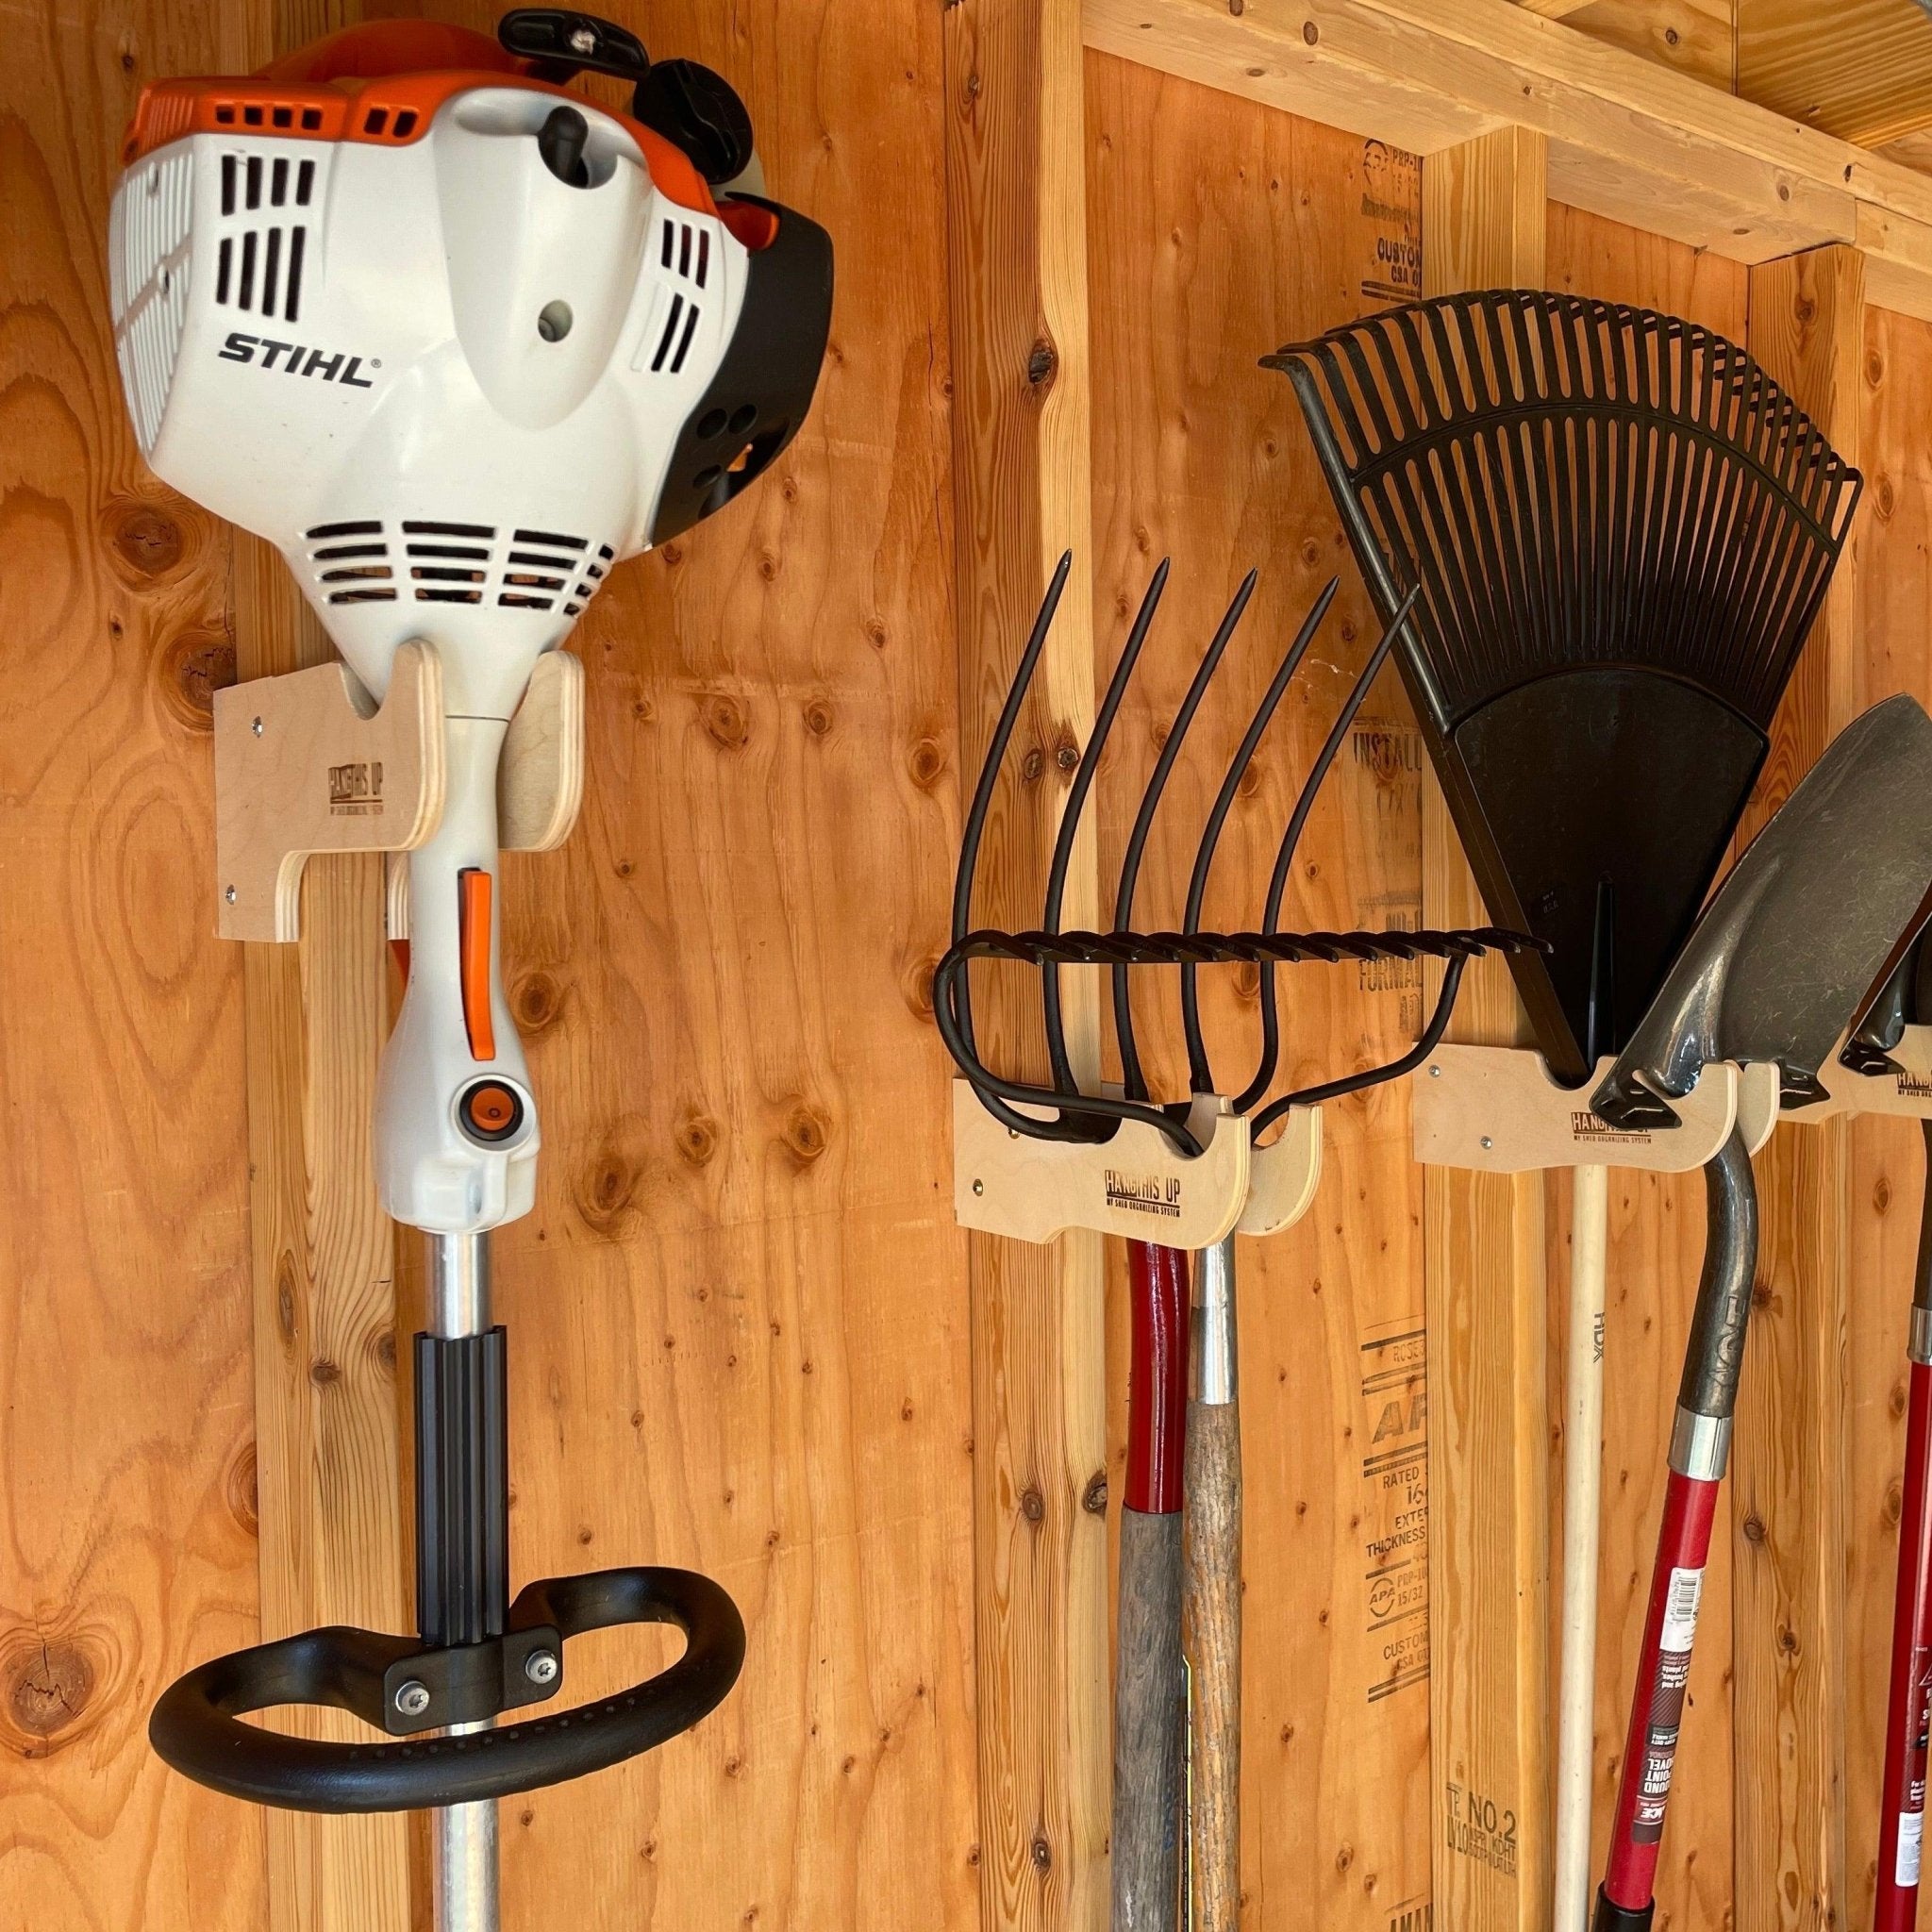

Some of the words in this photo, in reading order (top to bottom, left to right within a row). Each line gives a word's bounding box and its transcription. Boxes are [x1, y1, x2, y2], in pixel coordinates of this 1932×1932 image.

[1166, 1176, 1180, 1204] UP
[1160, 1207, 1180, 1218] SYSTEM
[1593, 1311, 1606, 1364] HDX
[1383, 1466, 1420, 1490] RATED
[1365, 1525, 1426, 1557] THICKNESS
[1369, 1587, 1395, 1606] APA
[1397, 1585, 1424, 1607] 15/32
